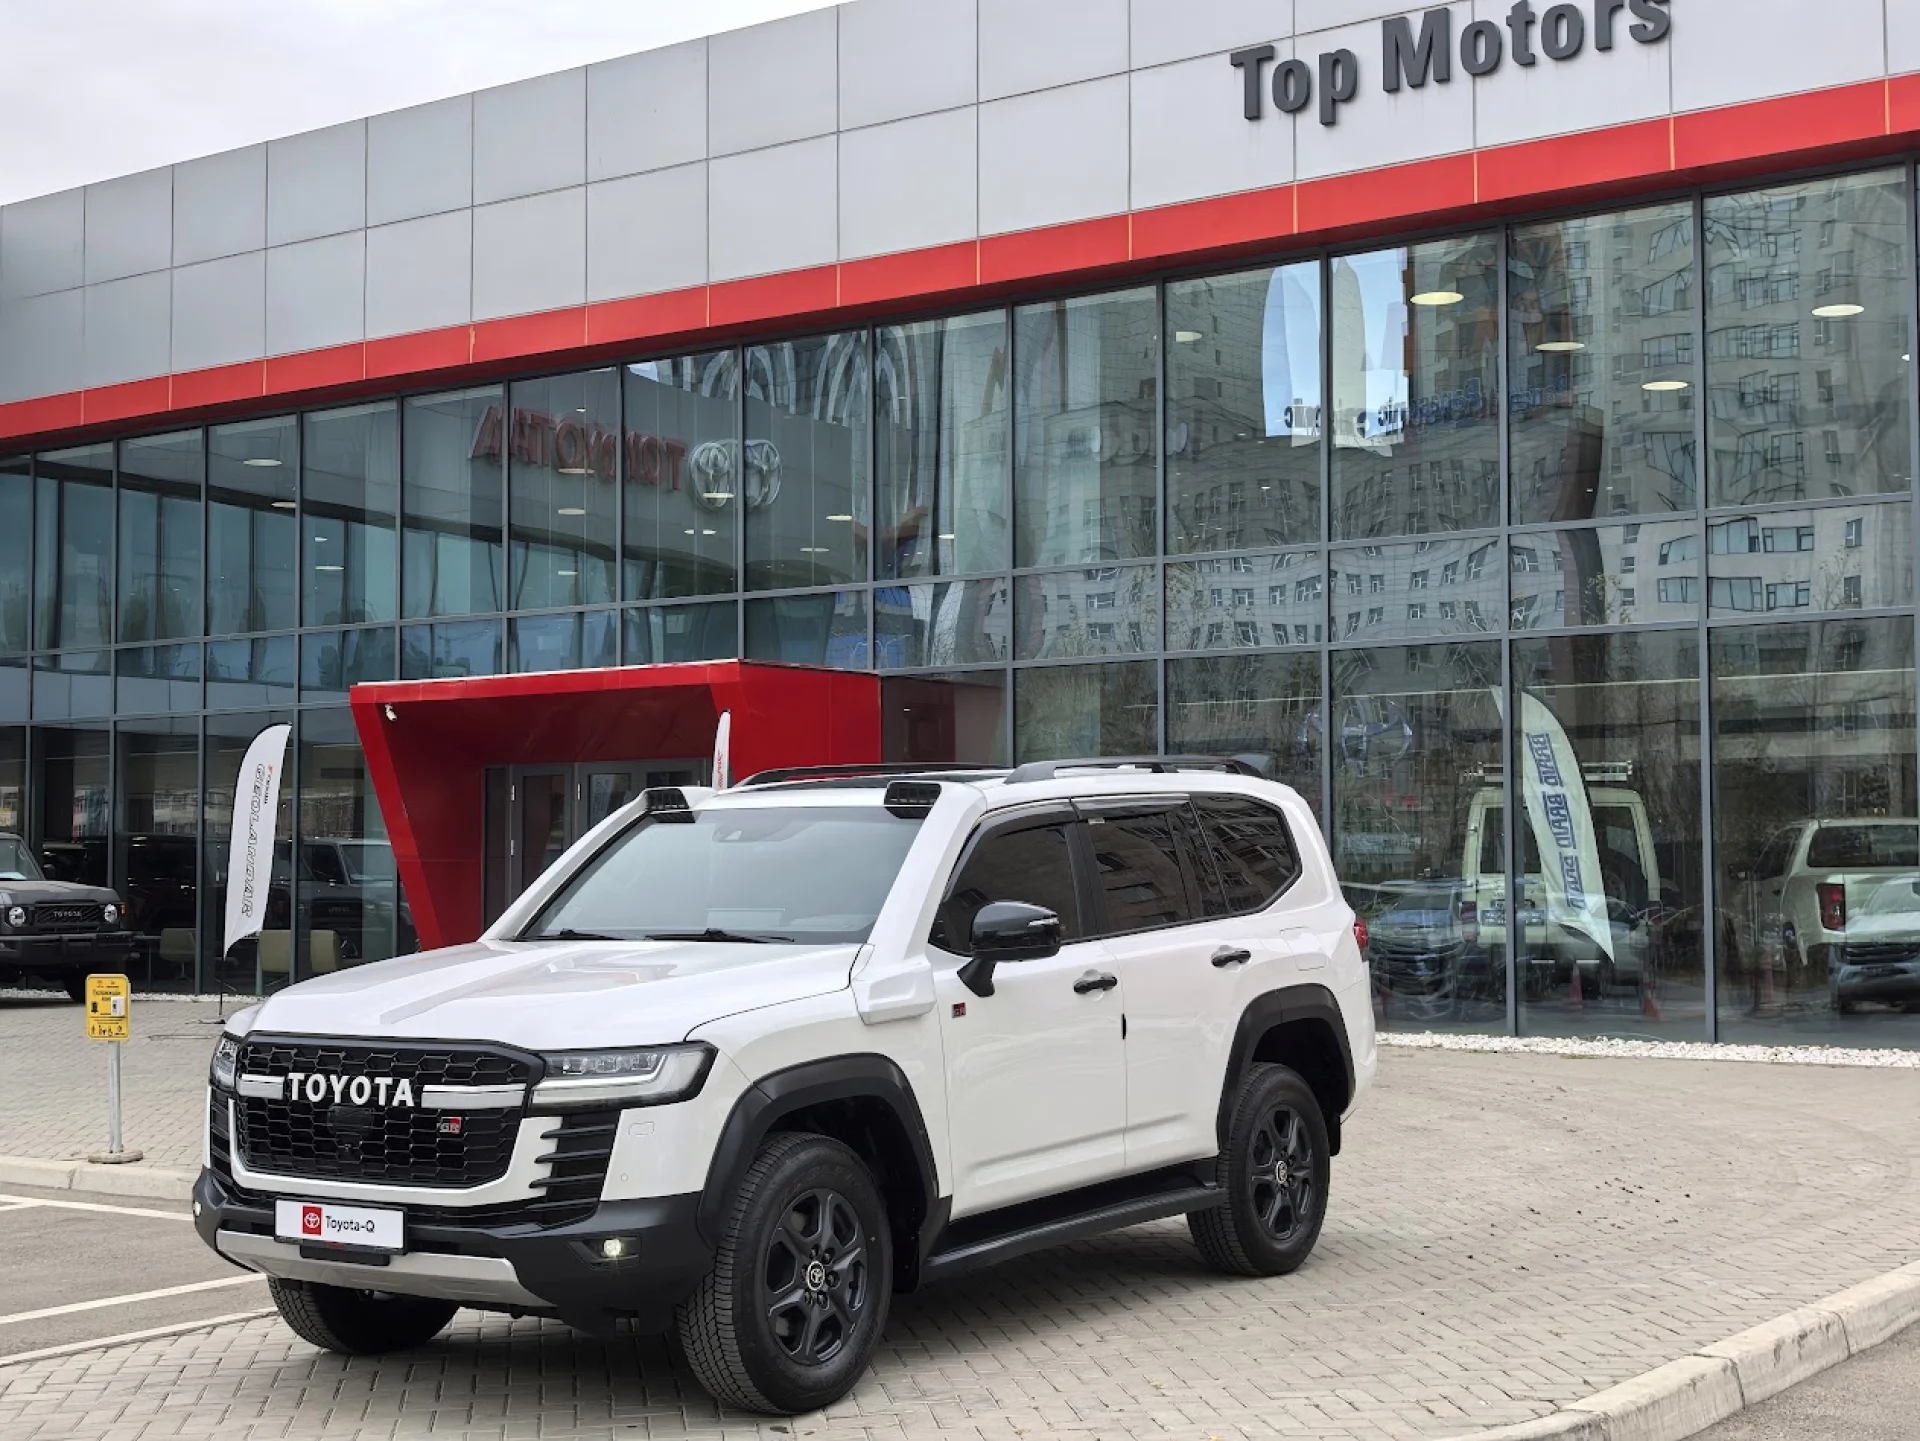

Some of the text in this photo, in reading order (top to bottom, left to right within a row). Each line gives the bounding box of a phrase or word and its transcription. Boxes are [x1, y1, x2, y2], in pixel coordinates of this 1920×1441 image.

[1230, 0, 1672, 126] Top Motors
[288, 1072, 415, 1107] TOYOTA
[438, 1117, 461, 1134] GR
[325, 1215, 375, 1233] Toyota-Q
